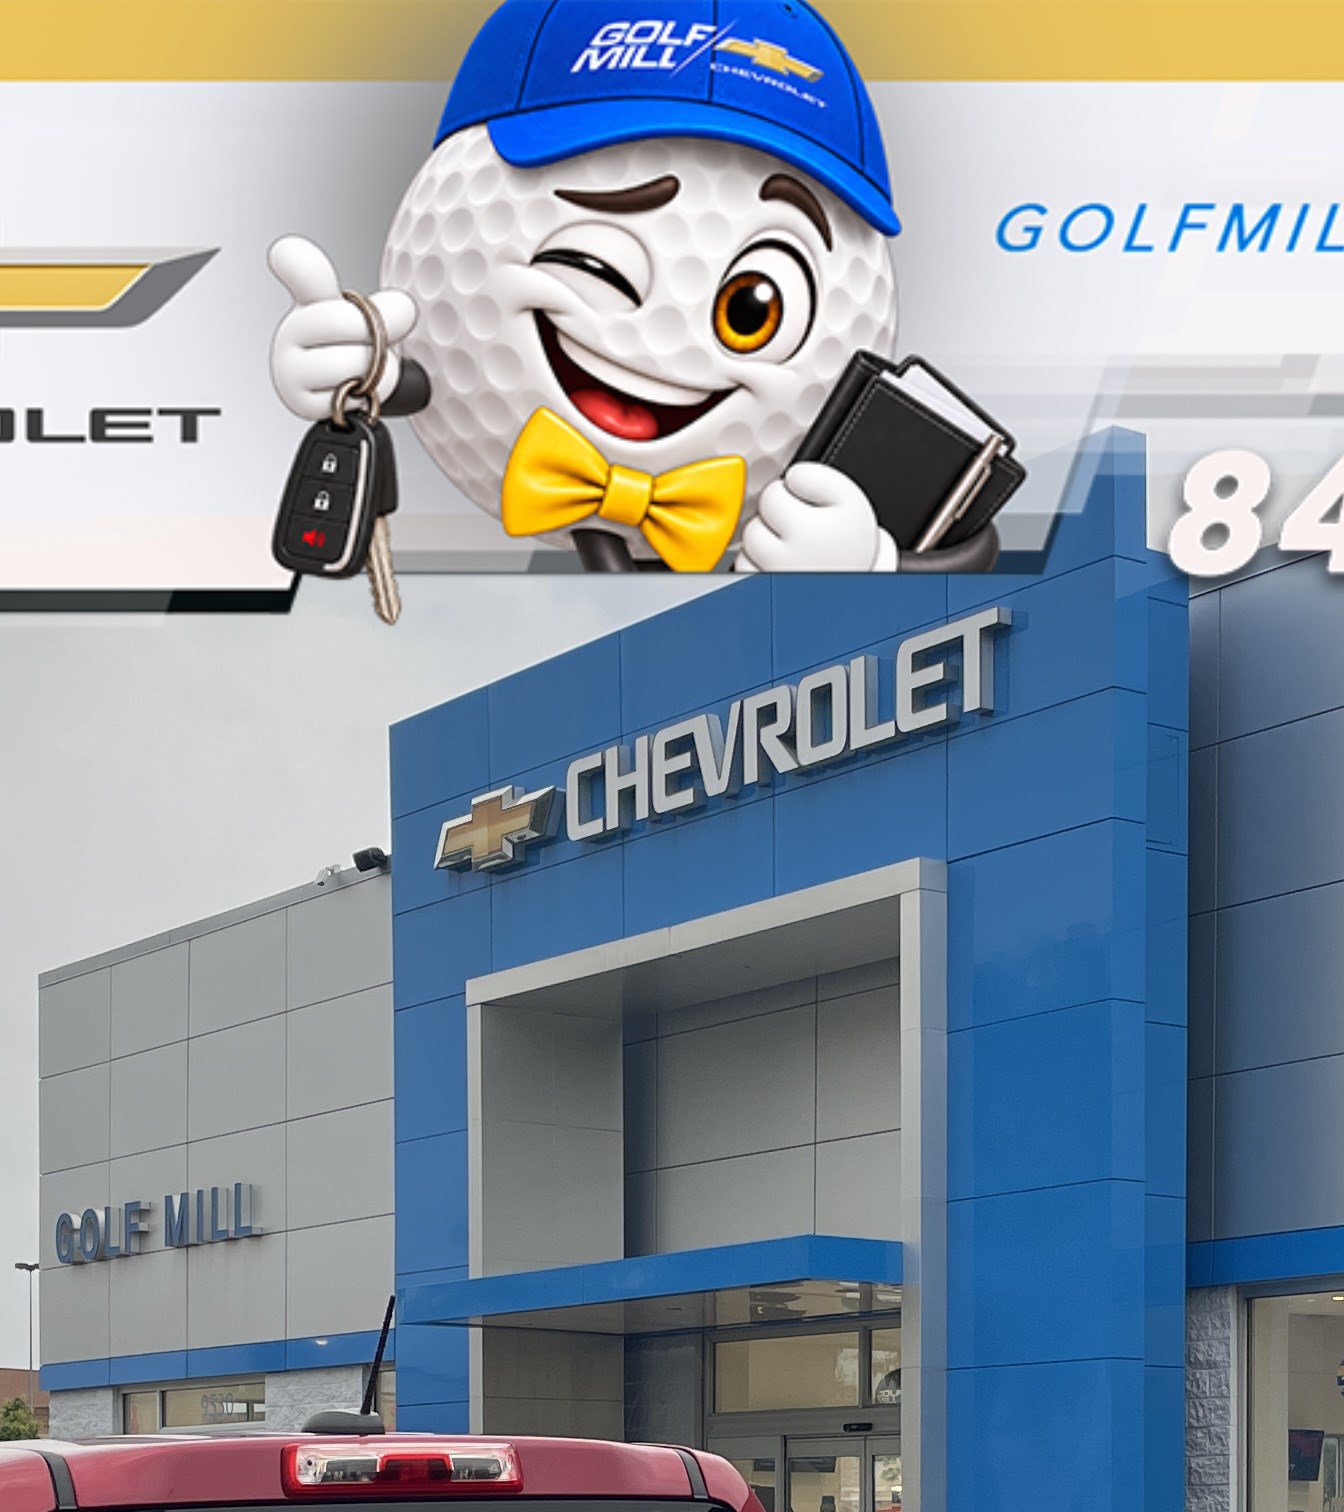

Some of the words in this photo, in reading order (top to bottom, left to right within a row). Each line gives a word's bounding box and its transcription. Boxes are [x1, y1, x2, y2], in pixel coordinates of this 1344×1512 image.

[566, 606, 1012, 844] CHEVROLET
[56, 1201, 150, 1265] GOLF
[164, 1182, 262, 1248] MILL
